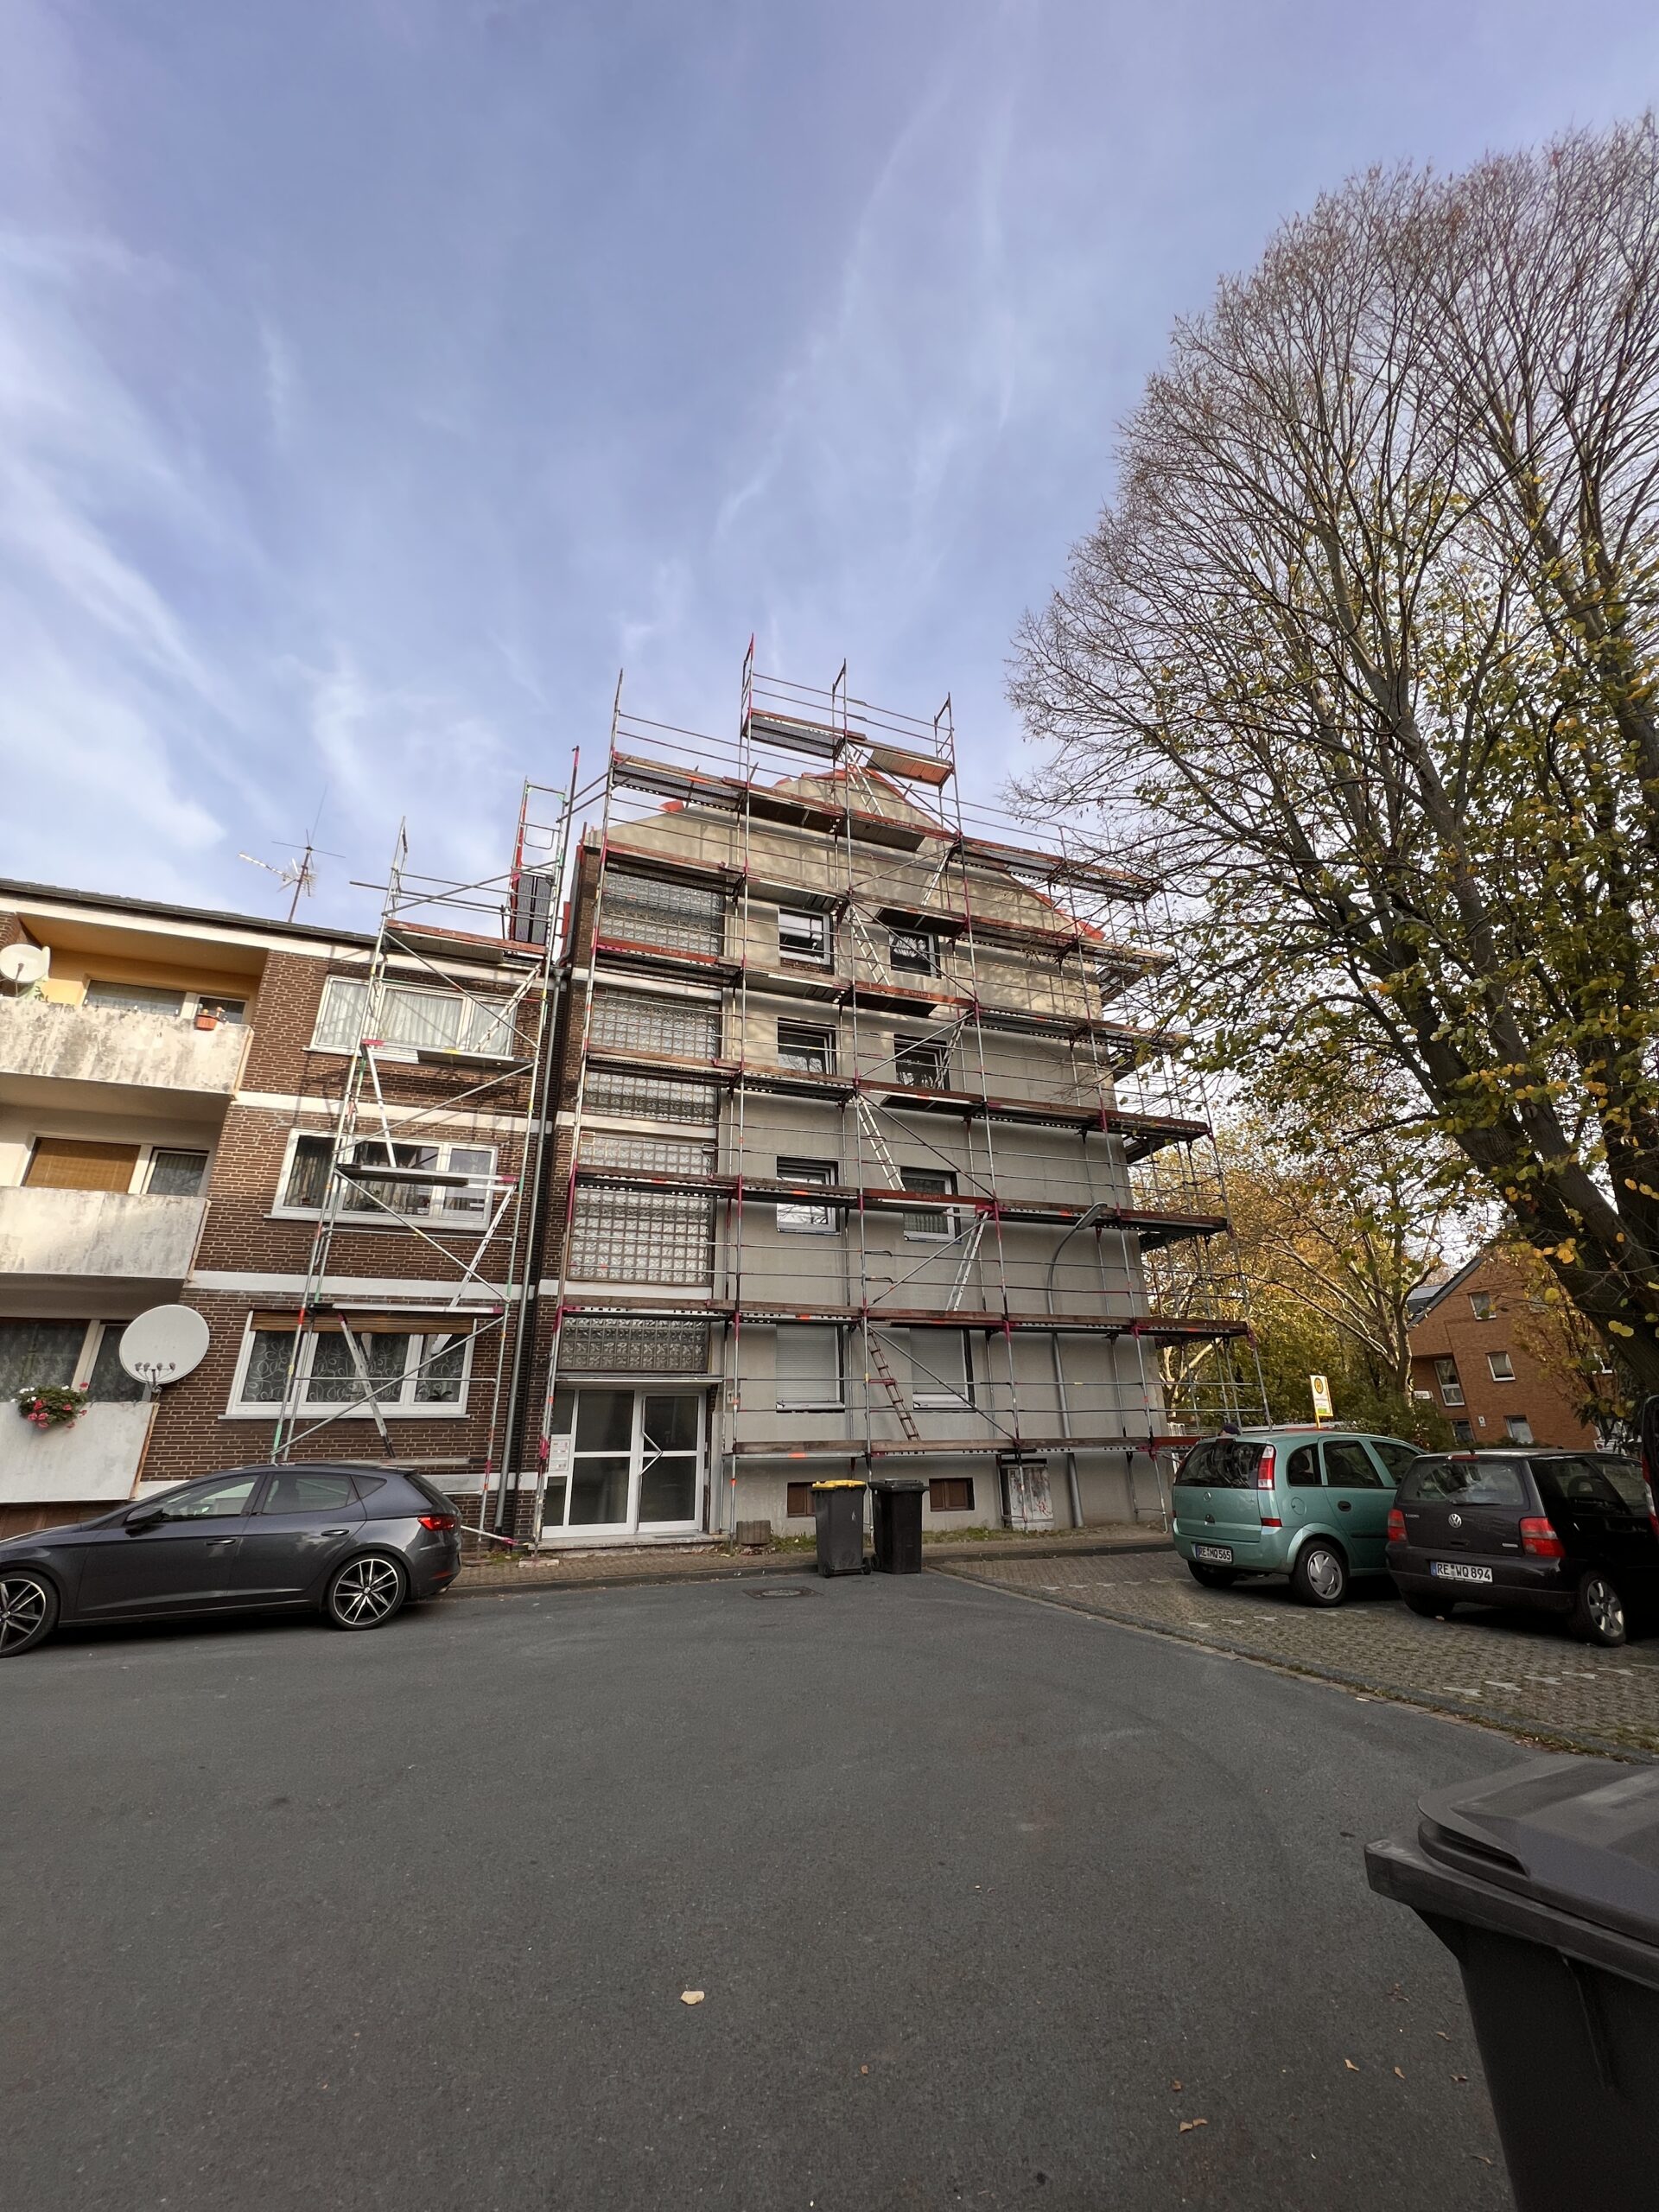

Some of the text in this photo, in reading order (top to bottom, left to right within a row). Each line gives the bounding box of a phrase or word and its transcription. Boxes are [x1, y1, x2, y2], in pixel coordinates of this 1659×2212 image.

[1437, 1563, 1491, 1580] RE WQ 894
